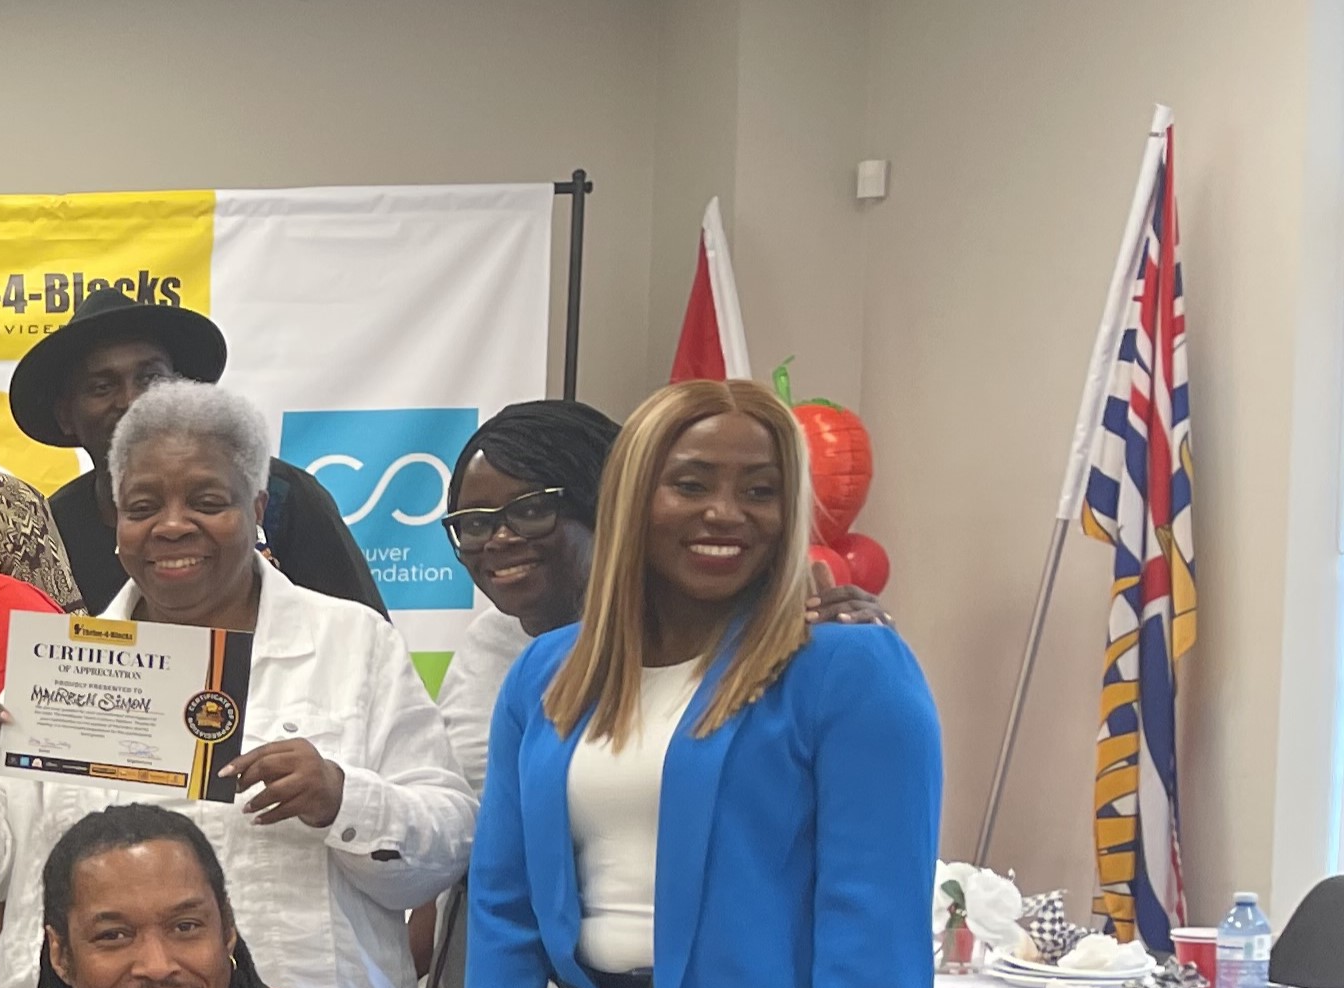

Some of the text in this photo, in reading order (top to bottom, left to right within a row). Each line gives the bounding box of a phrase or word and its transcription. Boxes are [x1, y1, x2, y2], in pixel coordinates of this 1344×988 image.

[33, 642, 171, 670] CERTIFICATE
[58, 664, 142, 680] OF APPRECIATION
